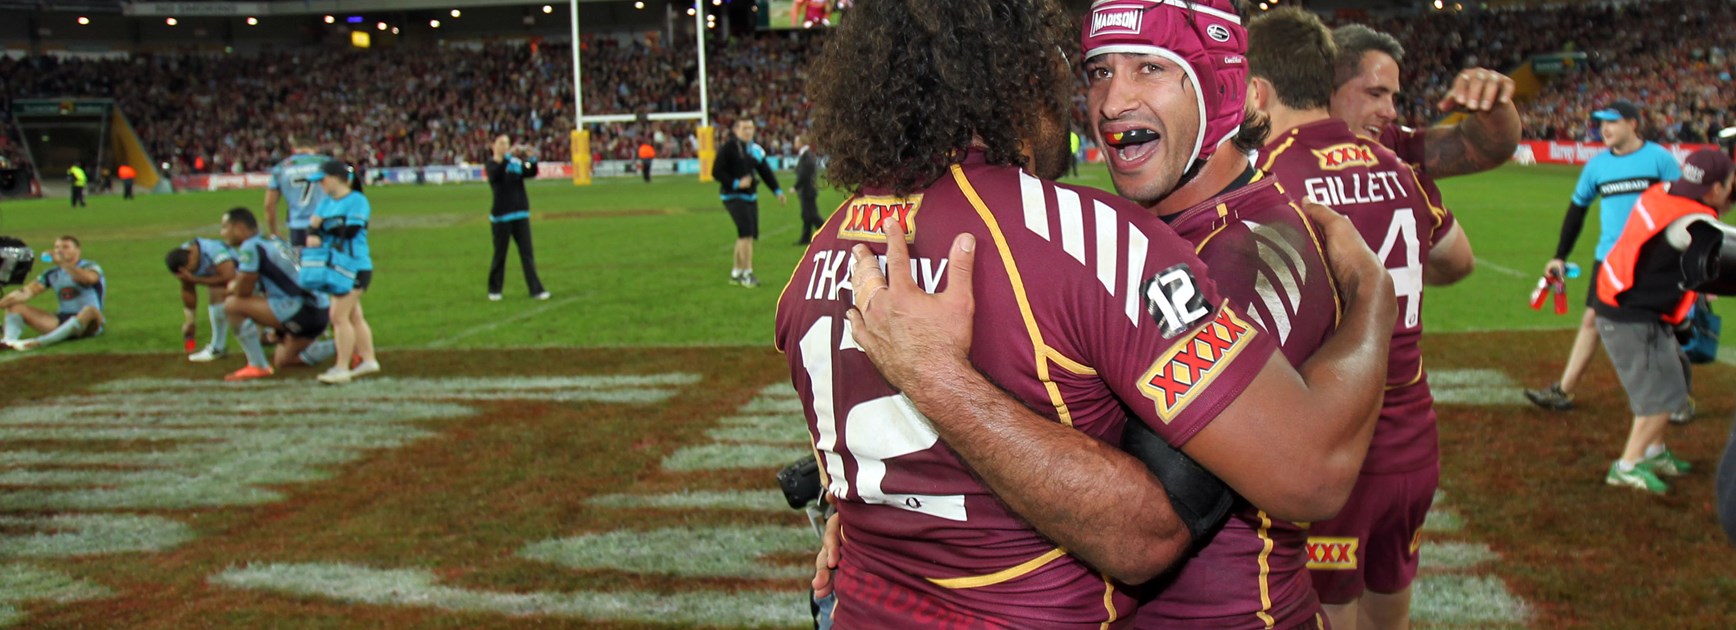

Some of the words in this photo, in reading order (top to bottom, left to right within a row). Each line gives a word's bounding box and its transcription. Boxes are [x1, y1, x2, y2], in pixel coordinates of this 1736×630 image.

[1093, 10, 1138, 33] MADISON
[289, 175, 316, 208] 7
[1304, 171, 1407, 206] GILLETT
[845, 203, 912, 234] XXXX
[1147, 269, 1208, 331] 12
[1148, 309, 1245, 410] XXXX
[798, 315, 968, 522] 12
